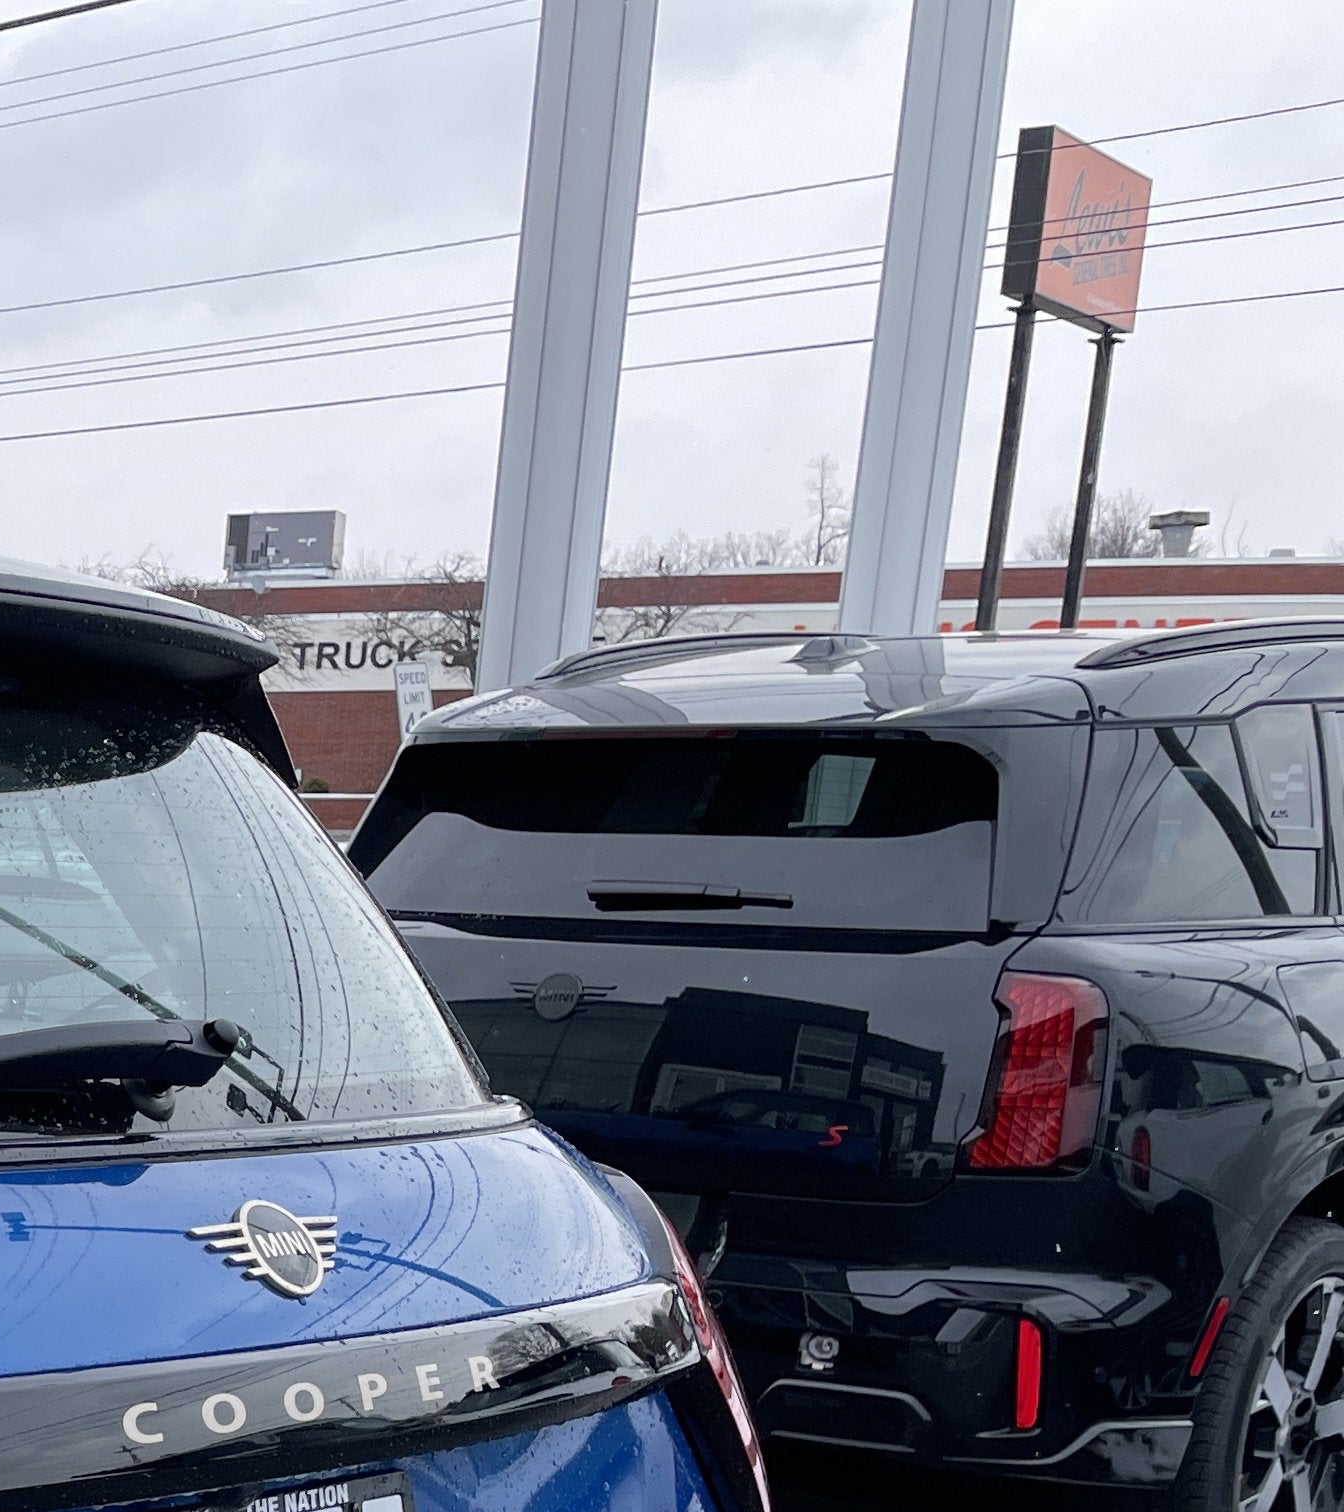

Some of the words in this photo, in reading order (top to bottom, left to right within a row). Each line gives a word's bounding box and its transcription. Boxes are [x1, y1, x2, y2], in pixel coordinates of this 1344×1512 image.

[293, 640, 422, 670] TRUCK
[399, 671, 426, 685] SPEED
[404, 691, 425, 705] LIMIT
[538, 992, 575, 1003] MINI
[818, 1125, 849, 1146] S
[255, 1230, 312, 1258] MINI
[122, 1355, 500, 1444] COOPER
